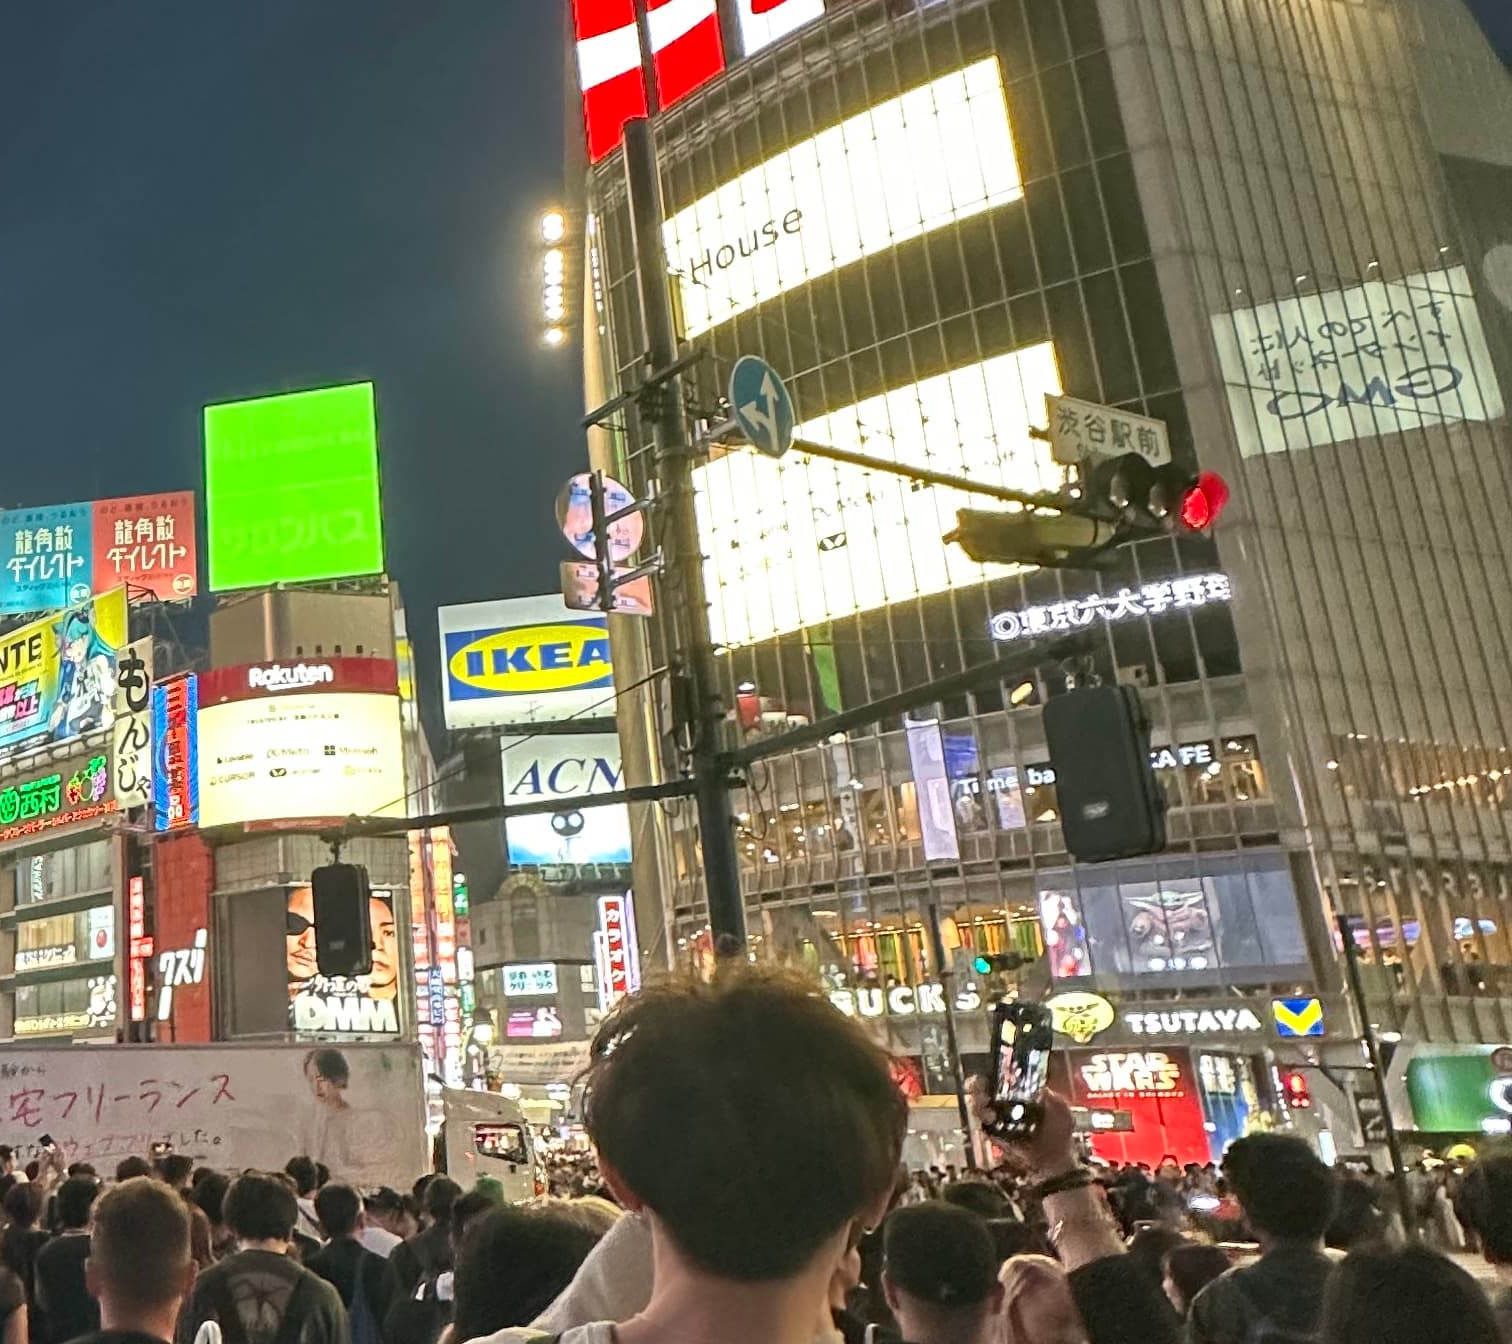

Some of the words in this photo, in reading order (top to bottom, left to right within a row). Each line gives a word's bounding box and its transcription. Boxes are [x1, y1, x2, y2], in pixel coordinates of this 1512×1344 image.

[1057, 406, 1161, 458] 渋谷駅前
[14, 524, 75, 556] 龍角散
[113, 514, 176, 546] 龍角散
[466, 639, 610, 678] IKEA
[249, 664, 334, 691] Rakuten
[116, 647, 152, 800] もんじゃ
[959, 774, 1019, 795] Time
[158, 928, 208, 1021] クスリ
[294, 991, 399, 1032] DMM
[1126, 1009, 1262, 1034] TSUTAYA
[1081, 1052, 1179, 1073] STAR
[1082, 1070, 1181, 1091] WARS
